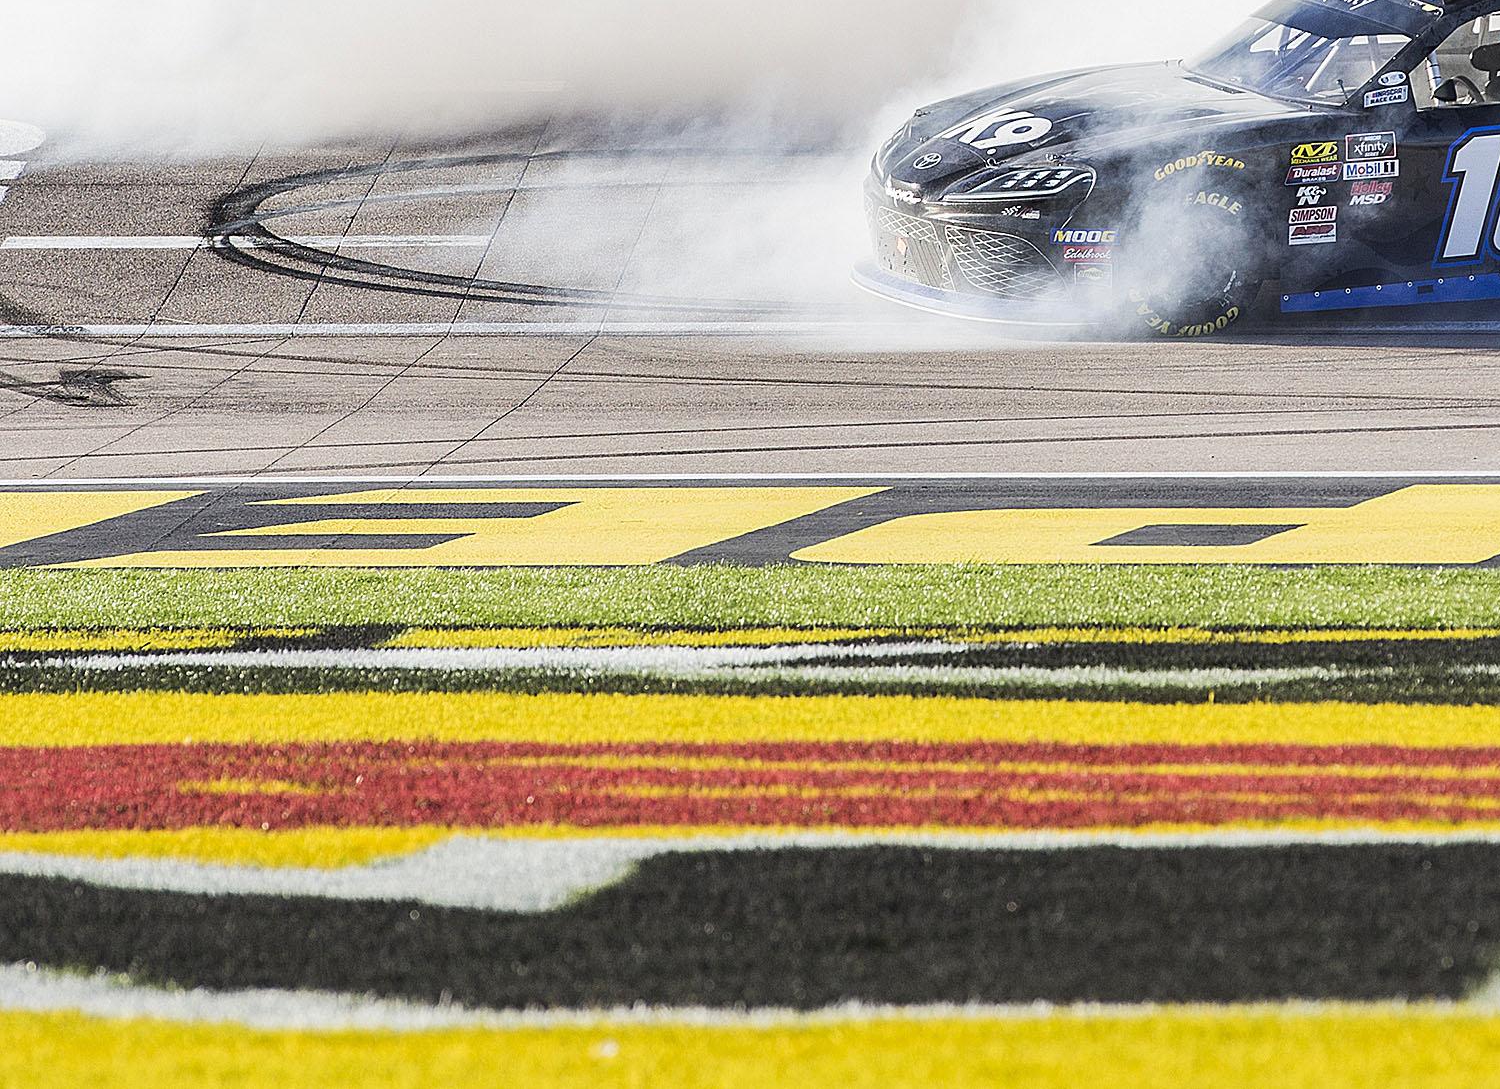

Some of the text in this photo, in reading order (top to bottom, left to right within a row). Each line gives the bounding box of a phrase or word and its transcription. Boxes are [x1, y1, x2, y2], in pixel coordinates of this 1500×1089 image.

[1354, 141, 1389, 156] xfinity
[1153, 150, 1248, 182] GOODYEAR
[1292, 164, 1338, 179] Duralast
[1346, 163, 1382, 177] Mobil
[1350, 180, 1394, 196] Holley
[1184, 190, 1243, 215] EAGLE
[1349, 194, 1387, 206] MSD
[1290, 207, 1335, 223] SIMPSON
[1053, 230, 1117, 243] MOOG
[1063, 248, 1111, 259] Edelbrock
